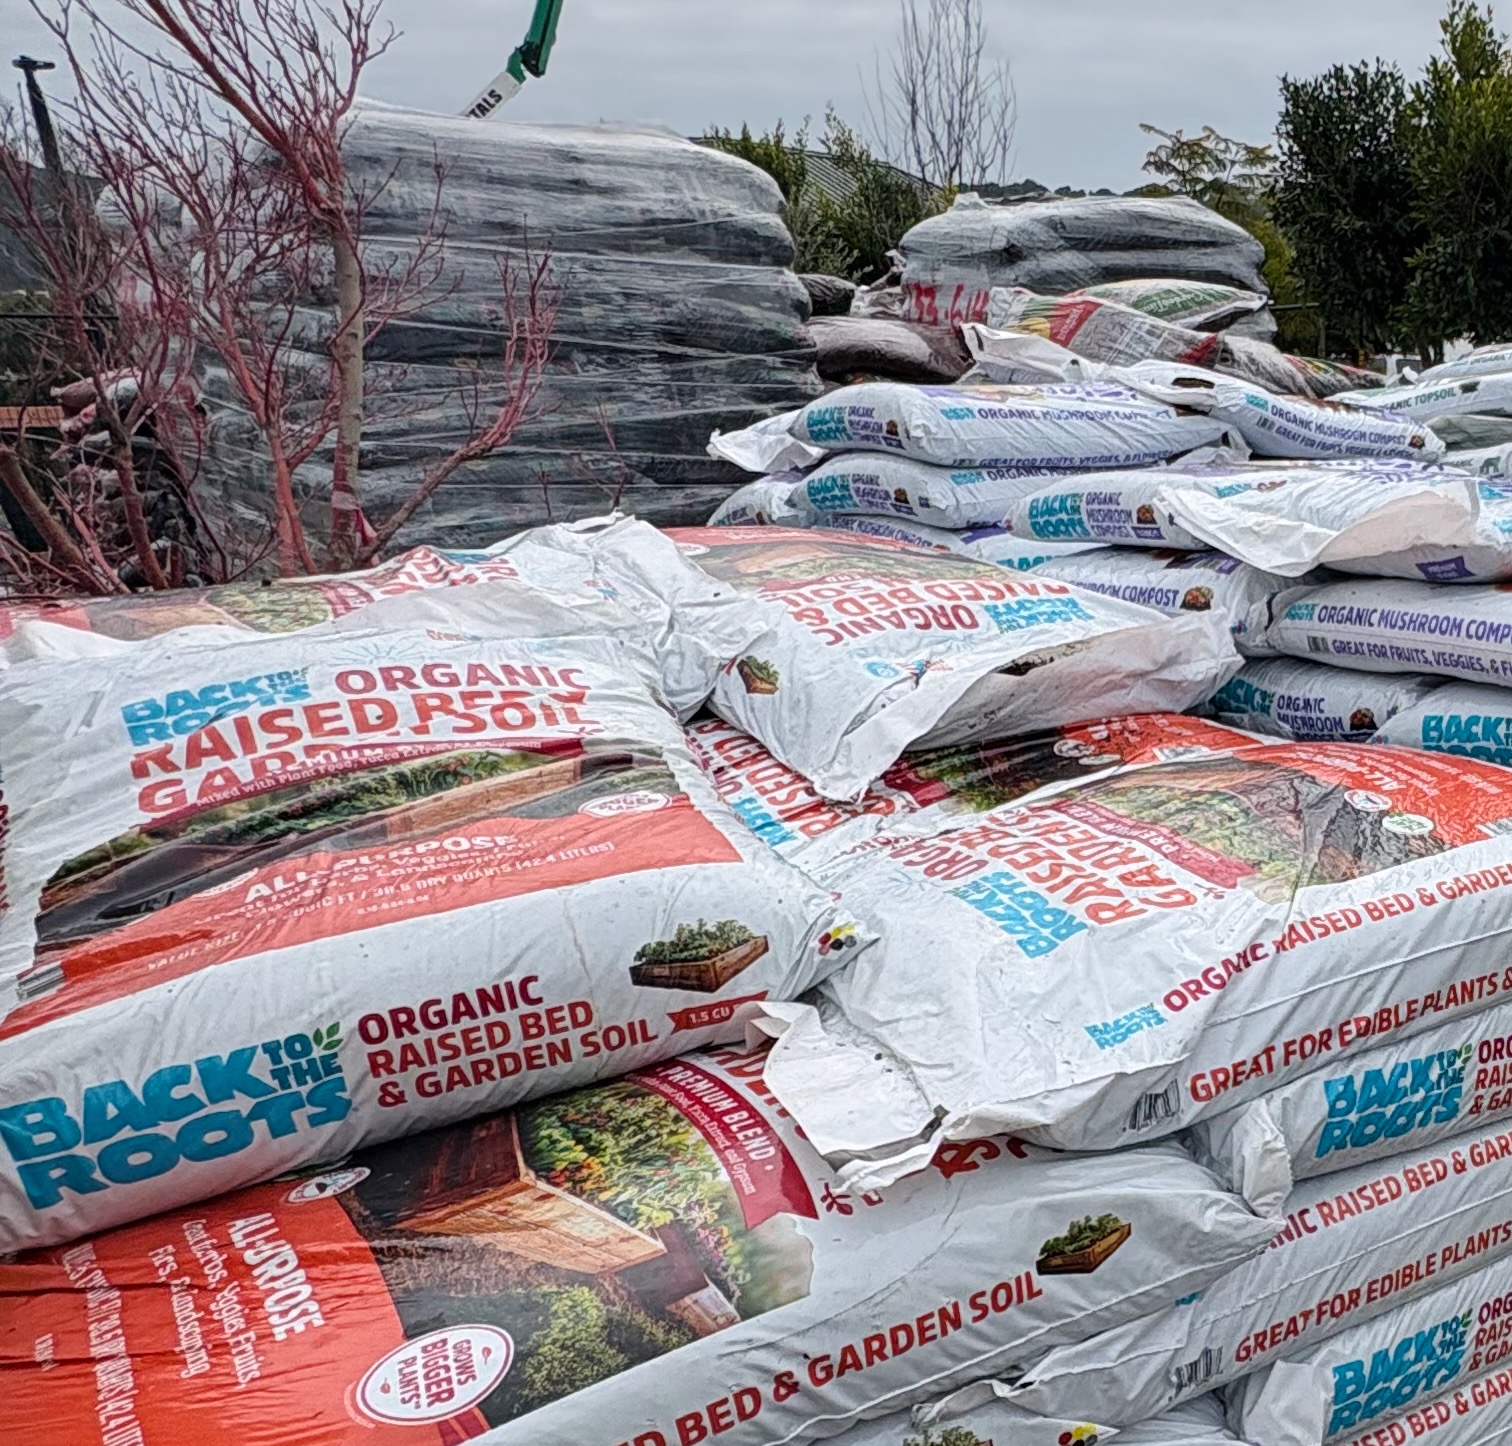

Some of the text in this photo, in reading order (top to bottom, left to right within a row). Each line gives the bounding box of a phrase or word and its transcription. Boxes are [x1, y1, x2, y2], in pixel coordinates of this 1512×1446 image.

[1415, 388, 1457, 406] TOPSOIL
[1120, 584, 1179, 607] COMPOST
[1317, 605, 1375, 628] ORGANIC
[1378, 608, 1464, 638] MUSHROOM
[335, 663, 591, 694] ORGANIC
[1332, 639, 1366, 659] GREAT
[1367, 644, 1389, 661] FOR
[1390, 646, 1434, 667] FRUITS,
[1433, 650, 1486, 672] VEGGIES,
[243, 768, 315, 793] with Plant
[357, 975, 544, 1046] ORGANIC
[367, 1001, 594, 1078] RAISED BED
[1190, 1047, 1276, 1103] GREAT
[1282, 1029, 1333, 1067] FOR
[1421, 976, 1498, 1017] PLANTS
[416, 1019, 659, 1098] GARDEN SOIL
[0, 1034, 343, 1162] BACK TO THE
[659, 1067, 775, 1160] PREMIUM BLEND
[16, 1076, 352, 1209] ROOTS
[1318, 1160, 1447, 1229] RAISED BED
[1235, 1216, 1511, 1363] GREAT FOR EDIBLE PLANTS
[453, 1339, 477, 1385] GROWS
[807, 1301, 964, 1387] GARDEN
[969, 1271, 1044, 1324] SOIL
[421, 1338, 455, 1407] BIGGER
[1410, 1401, 1451, 1437] BED
